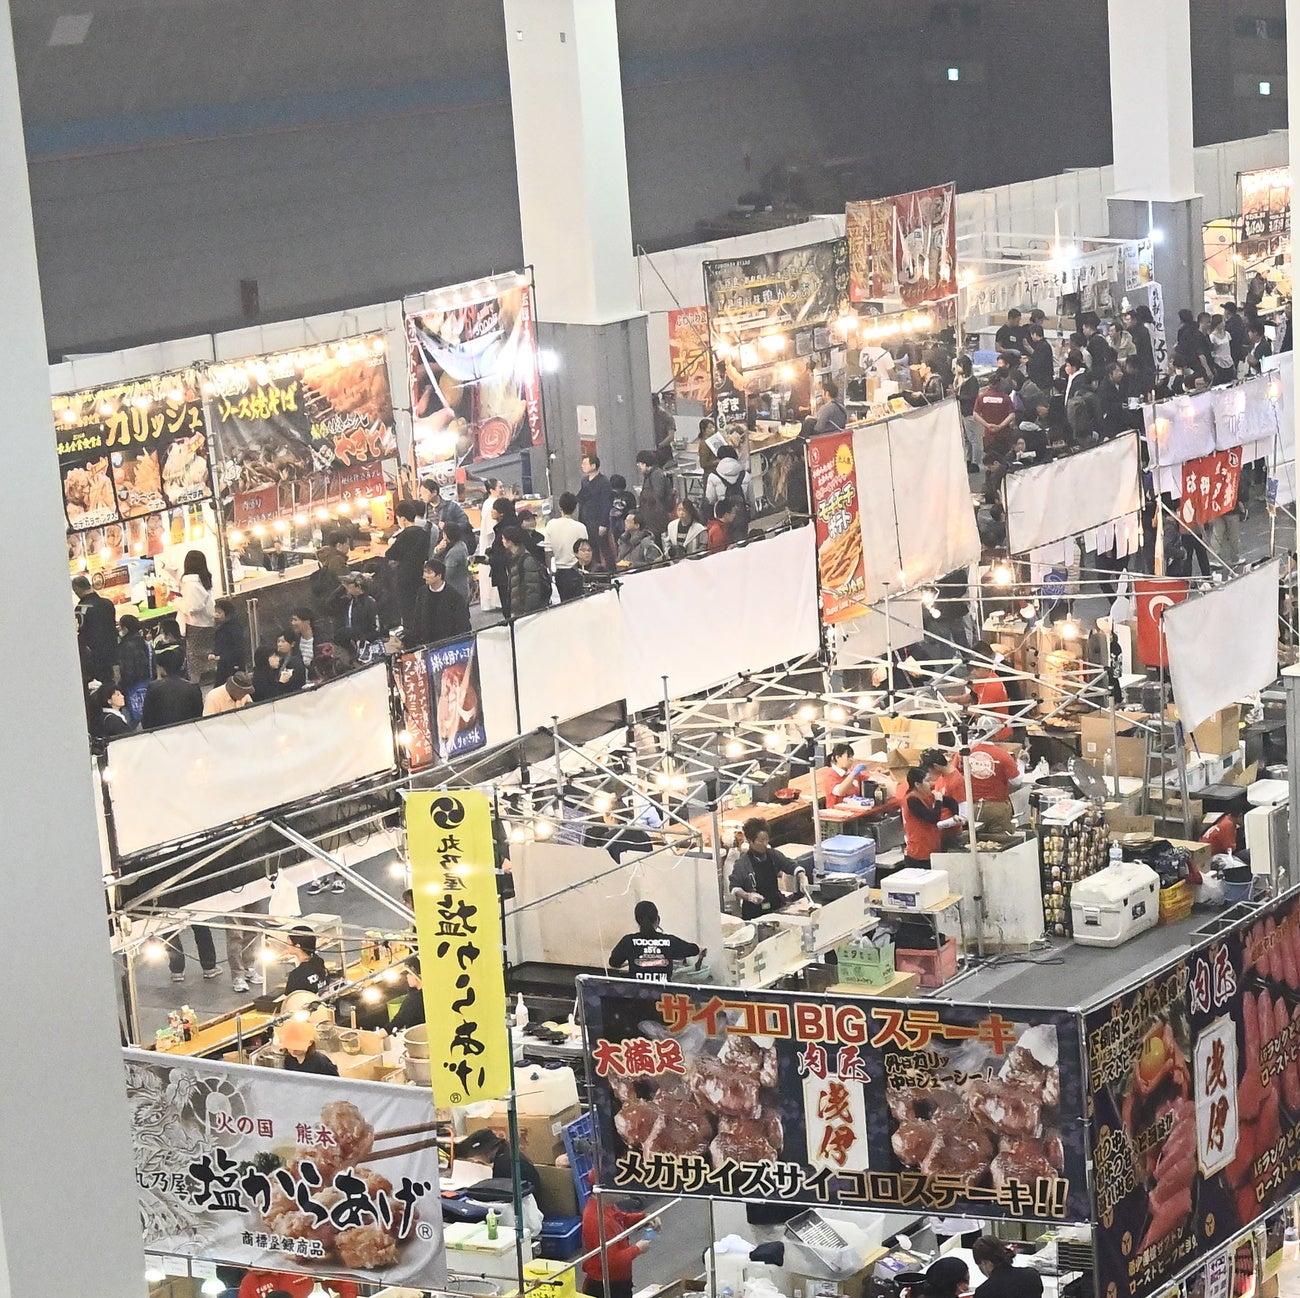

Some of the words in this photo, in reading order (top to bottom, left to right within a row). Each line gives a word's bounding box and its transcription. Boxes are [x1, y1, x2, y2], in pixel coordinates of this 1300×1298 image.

[1189, 943, 1237, 1015] 肉匠
[592, 1036, 687, 1077] 大満足
[797, 1041, 872, 1084] 肉匠
[216, 1111, 274, 1139] 火の国
[295, 1121, 336, 1148] 熊本
[189, 1149, 432, 1239] 塩からあげ
